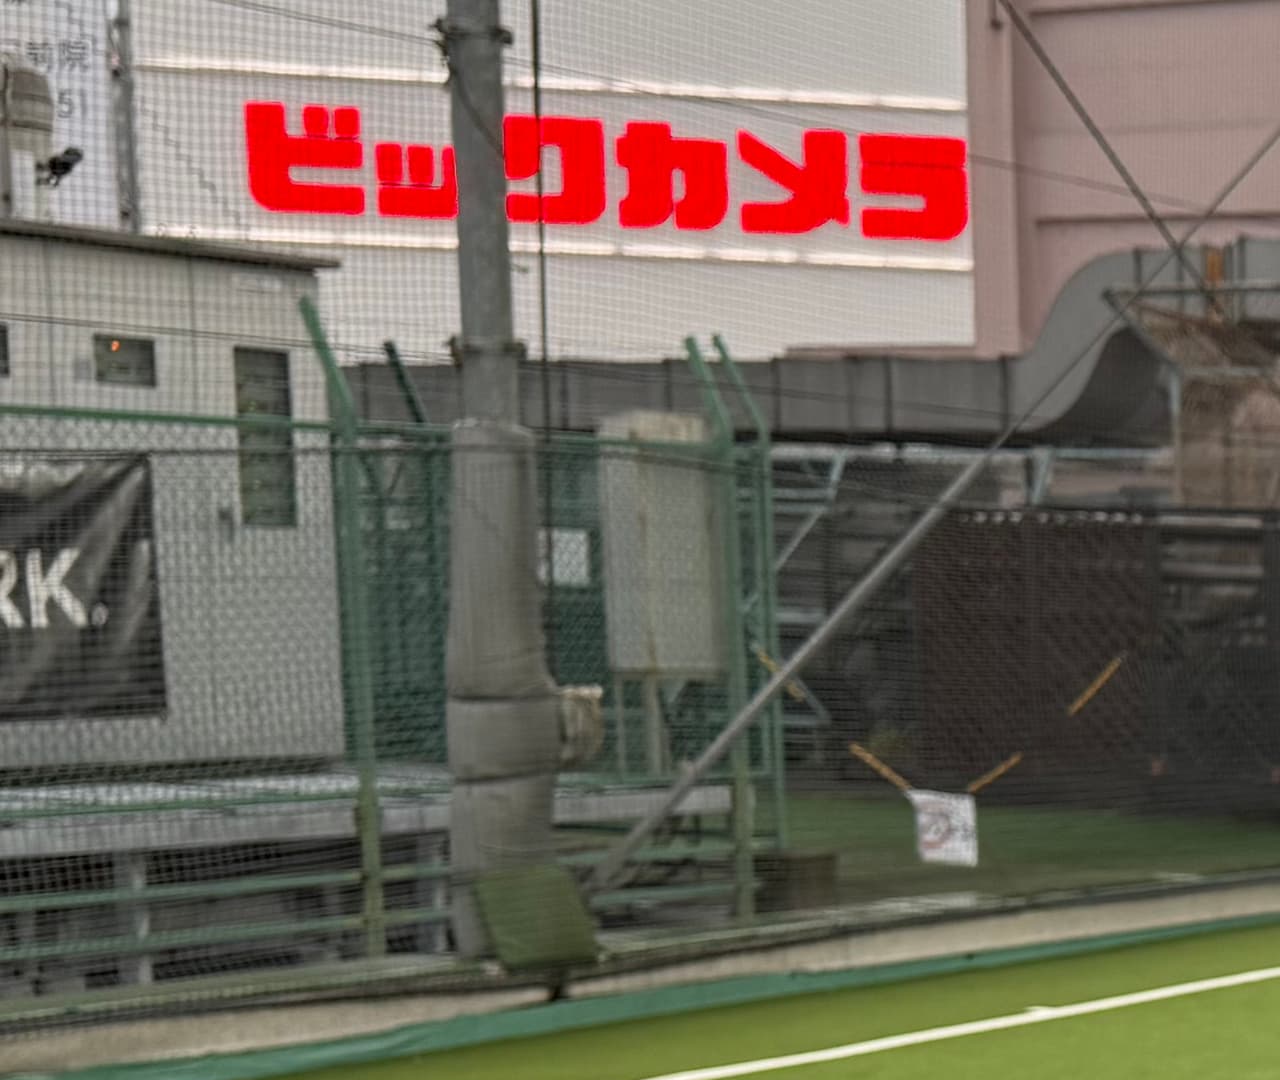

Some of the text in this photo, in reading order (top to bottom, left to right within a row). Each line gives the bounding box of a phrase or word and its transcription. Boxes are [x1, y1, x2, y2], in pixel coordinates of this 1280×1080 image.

[244, 101, 968, 241] ビックカメラ
